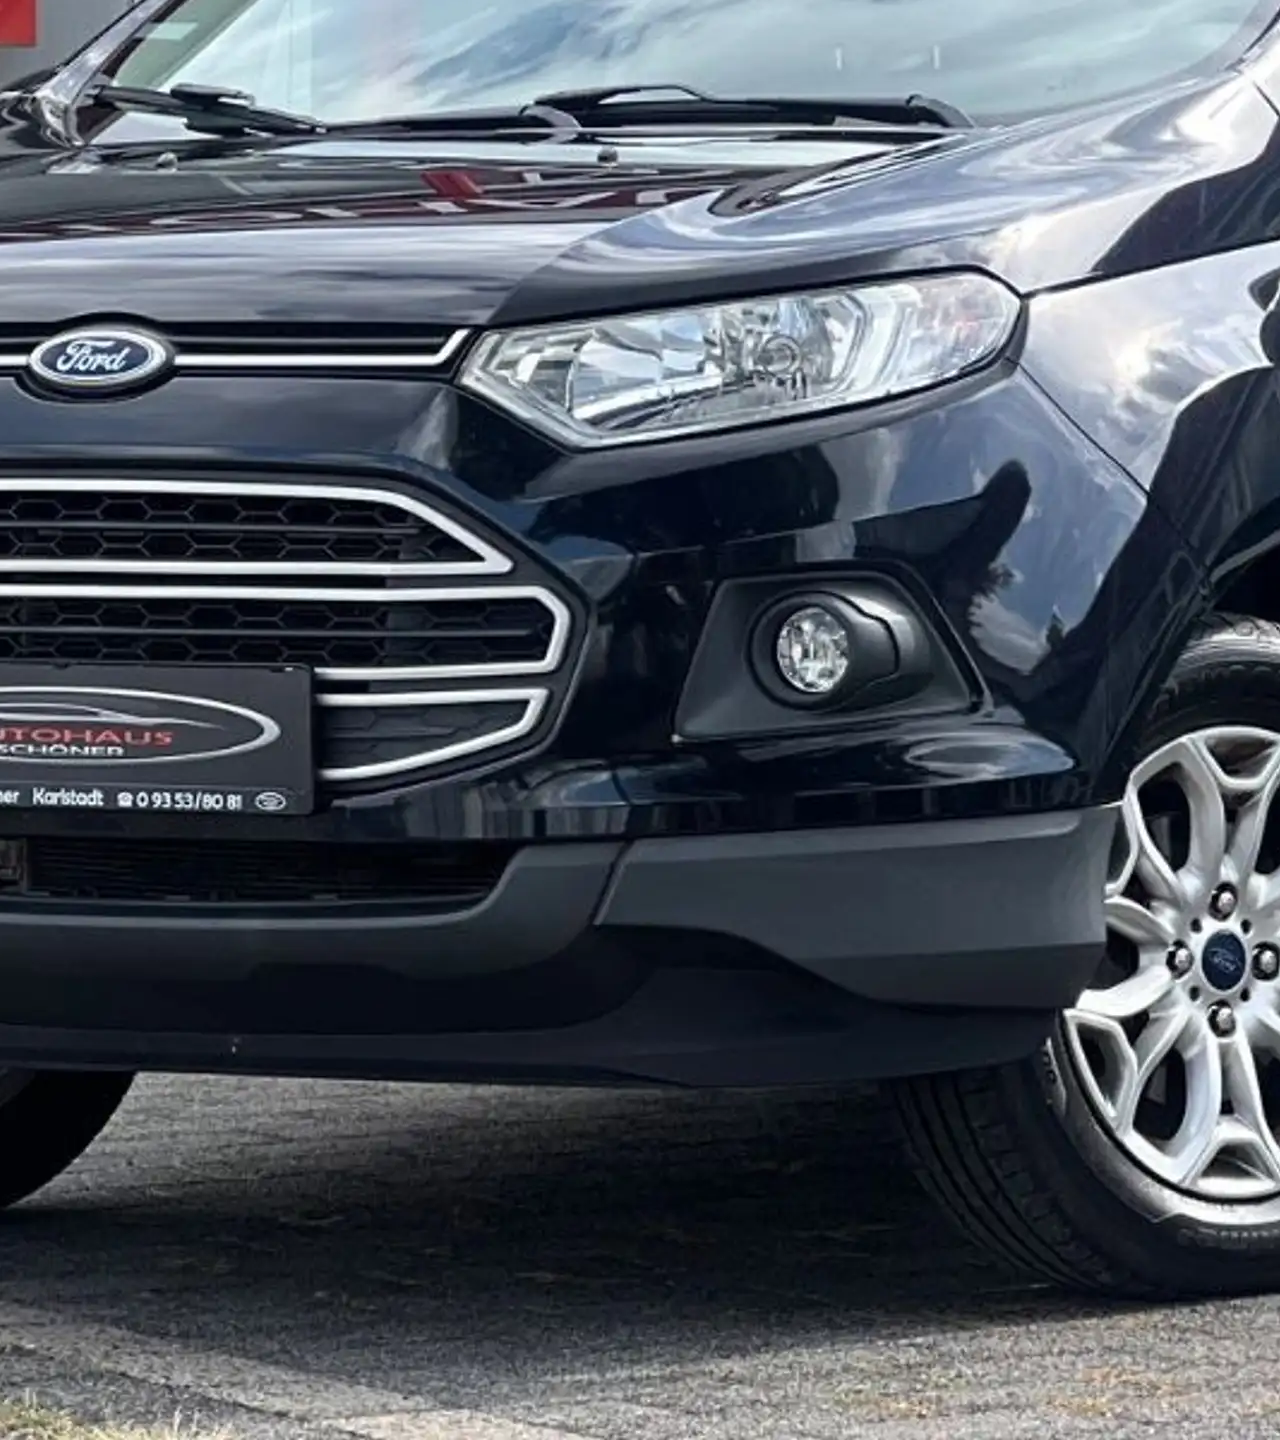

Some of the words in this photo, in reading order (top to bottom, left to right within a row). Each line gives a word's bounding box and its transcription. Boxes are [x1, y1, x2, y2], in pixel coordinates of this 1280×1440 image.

[56, 339, 131, 372] Ford
[32, 787, 105, 807] Karlstadt
[135, 791, 150, 808] 0
